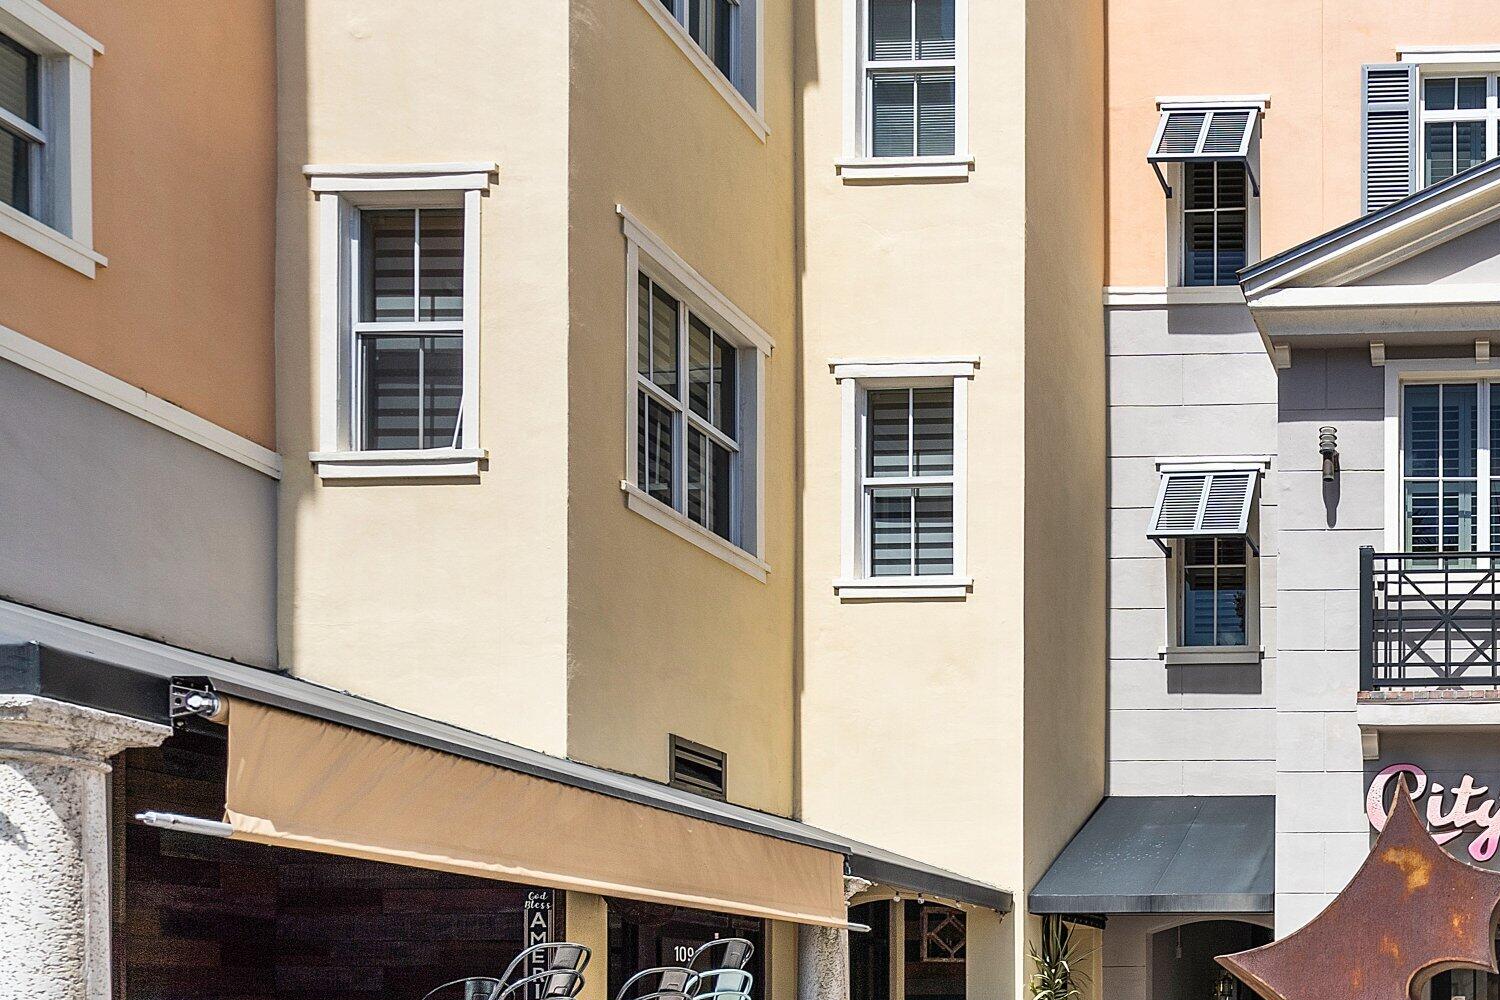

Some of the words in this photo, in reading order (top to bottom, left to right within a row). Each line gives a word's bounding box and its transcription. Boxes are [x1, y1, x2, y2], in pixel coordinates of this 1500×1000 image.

[528, 891, 548, 900] God
[524, 901, 552, 910] Bless
[674, 945, 695, 962] 109
